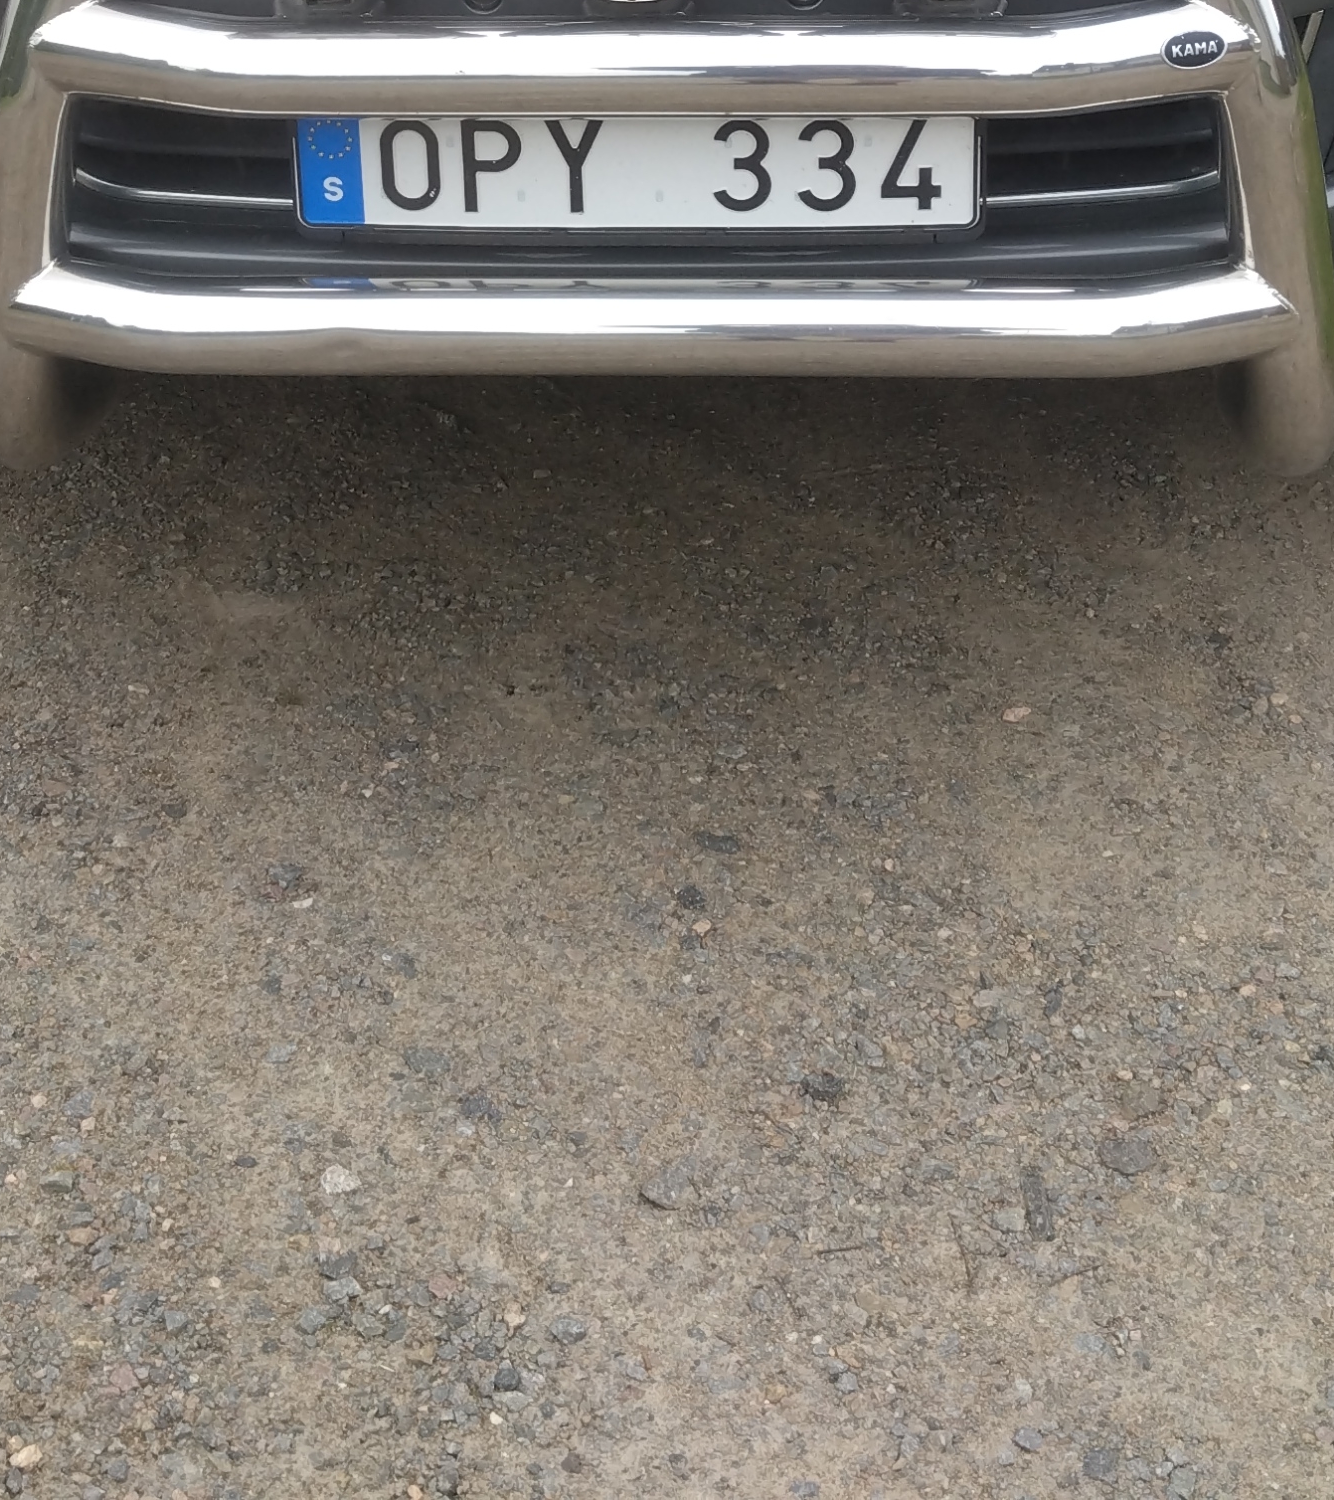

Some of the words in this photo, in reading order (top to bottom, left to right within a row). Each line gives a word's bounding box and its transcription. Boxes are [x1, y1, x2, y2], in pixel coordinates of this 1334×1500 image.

[1171, 40, 1218, 58] KAMA
[379, 118, 604, 213] OPY
[713, 118, 942, 212] 334
[323, 176, 344, 202] S
